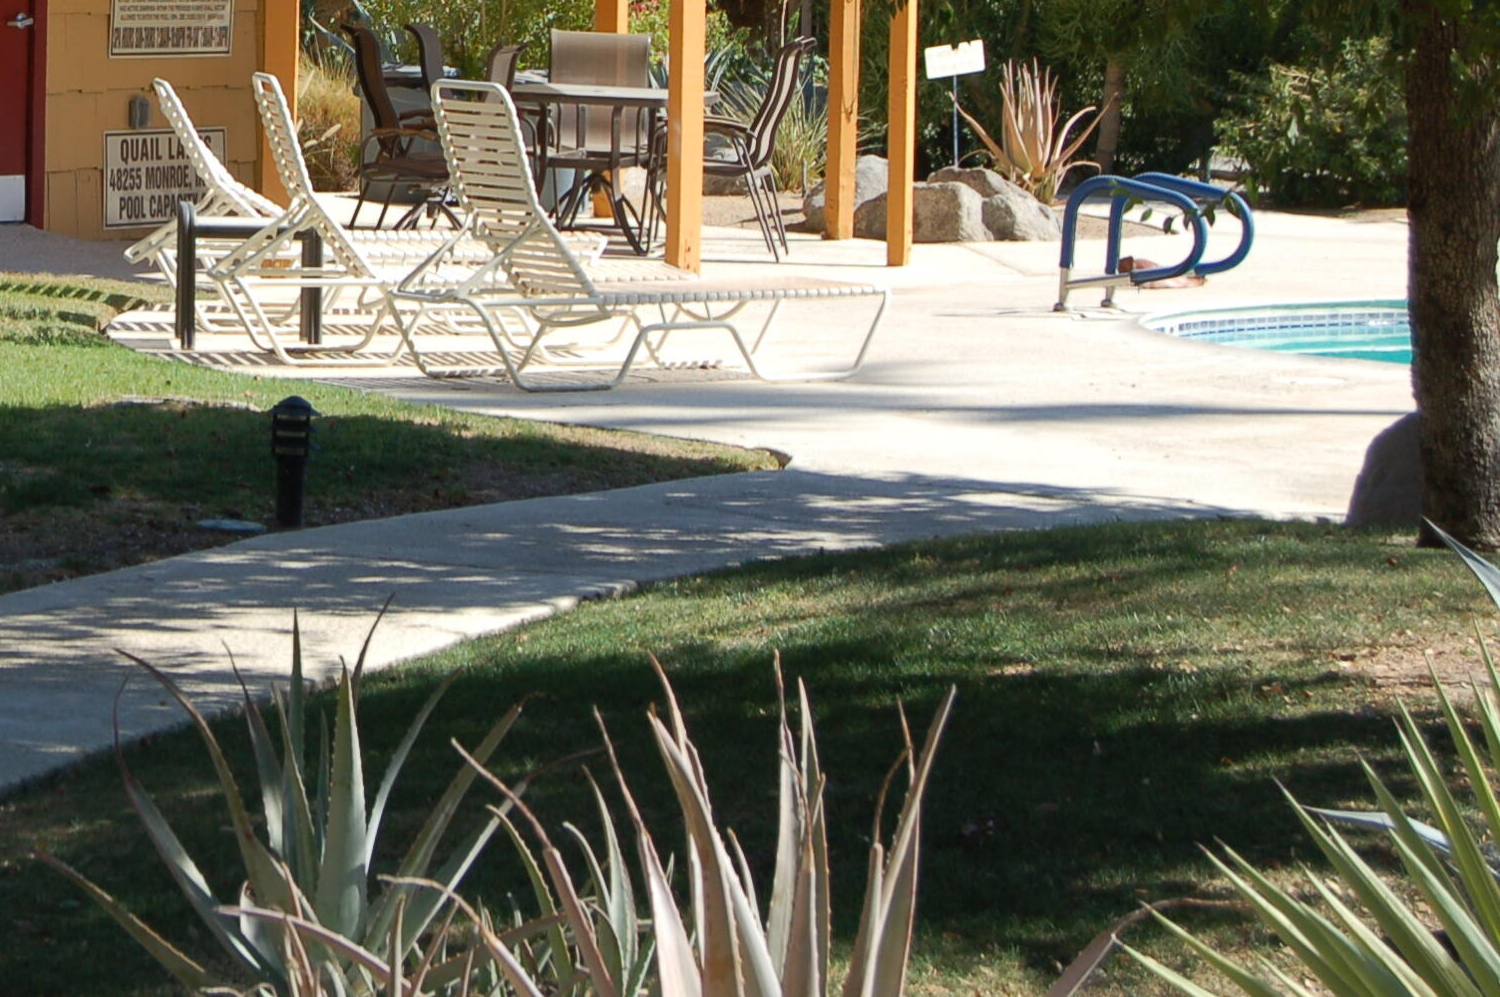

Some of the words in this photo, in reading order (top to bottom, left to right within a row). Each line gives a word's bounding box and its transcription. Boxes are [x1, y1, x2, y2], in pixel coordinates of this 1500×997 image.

[120, 137, 162, 164] QUAIL
[168, 134, 212, 160] LAS
[109, 167, 142, 191] 48255
[145, 165, 192, 190] MONROE,
[119, 195, 146, 220] POOL
